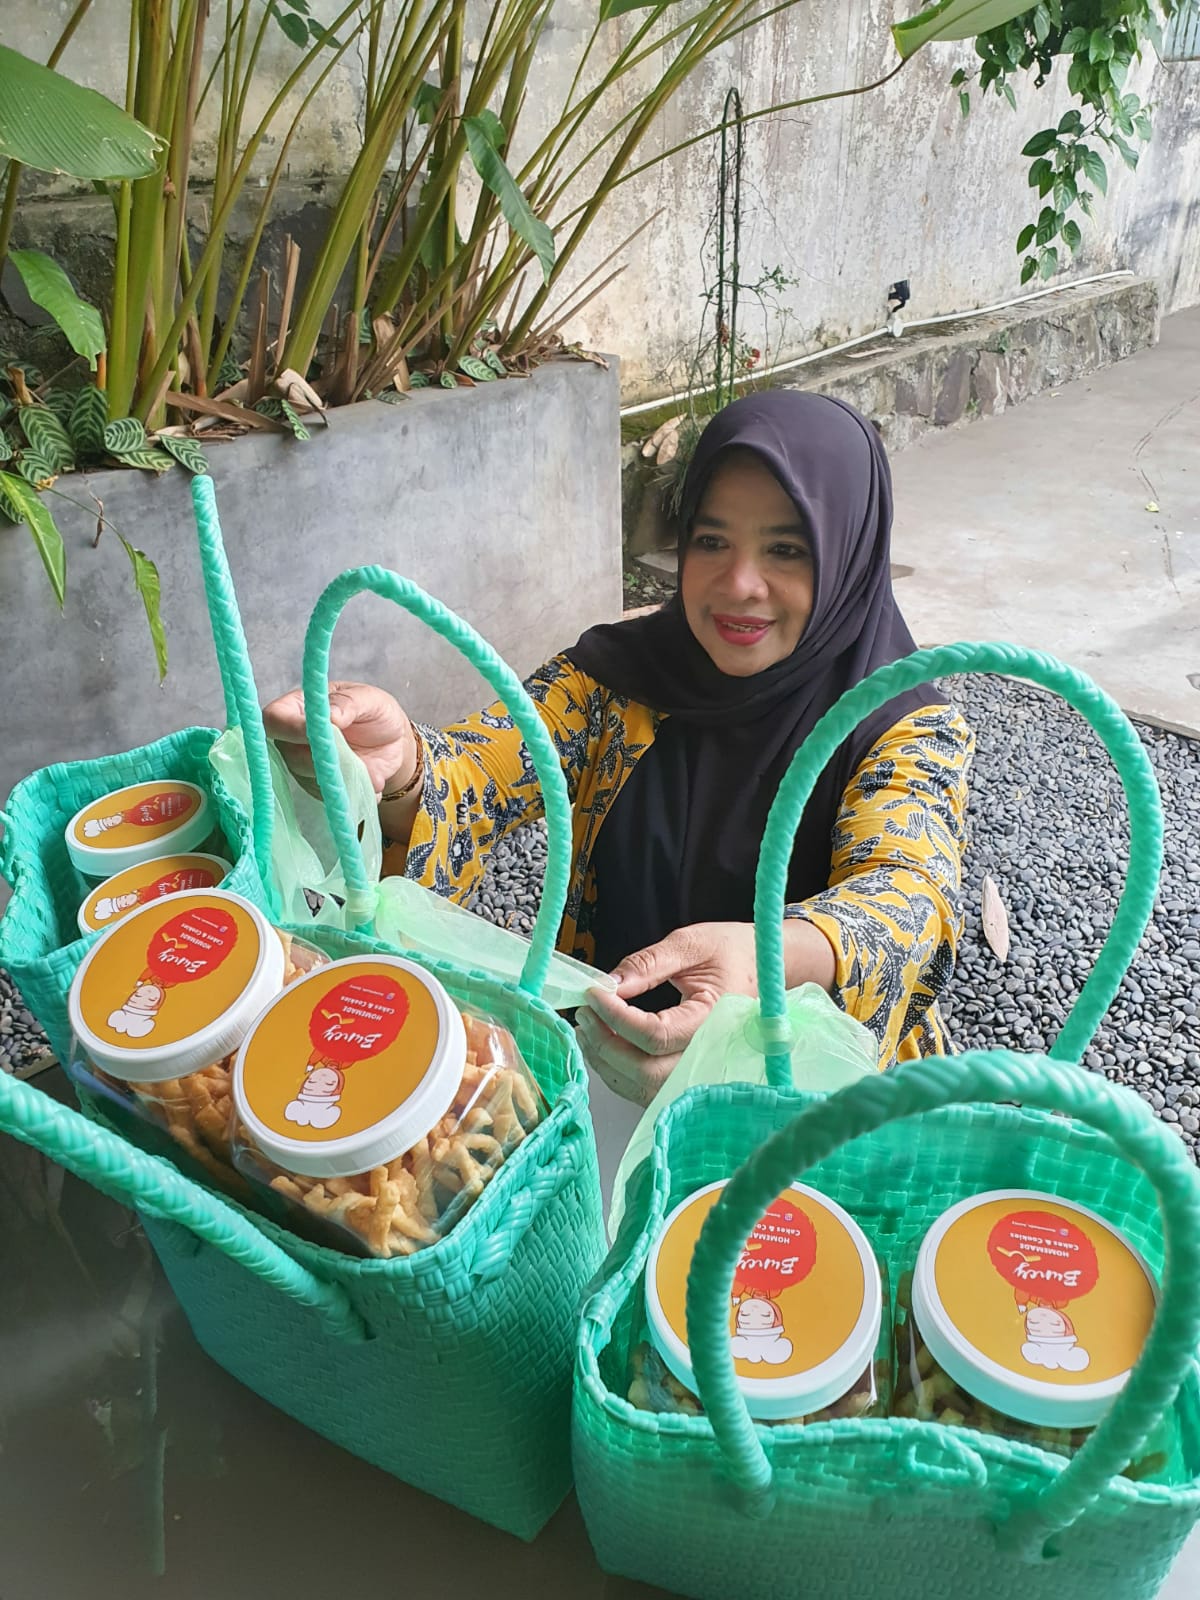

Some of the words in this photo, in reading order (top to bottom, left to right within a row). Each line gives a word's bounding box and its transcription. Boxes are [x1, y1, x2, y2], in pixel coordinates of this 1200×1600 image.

[158, 948, 207, 973] Buncy
[340, 996, 367, 1007] Cookies
[342, 1005, 383, 1021] HOMEMADE
[374, 1005, 395, 1015] Cakes
[323, 1024, 383, 1048] Buncy
[776, 1226, 801, 1236] Cakes
[750, 1232, 790, 1244] HOMEMA
[1010, 1232, 1043, 1244] Cookies
[1019, 1243, 1069, 1258] HOMEMADE
[1053, 1241, 1079, 1251] Cakes
[736, 1251, 799, 1274] Buncy
[1013, 1262, 1082, 1286] Buncy
